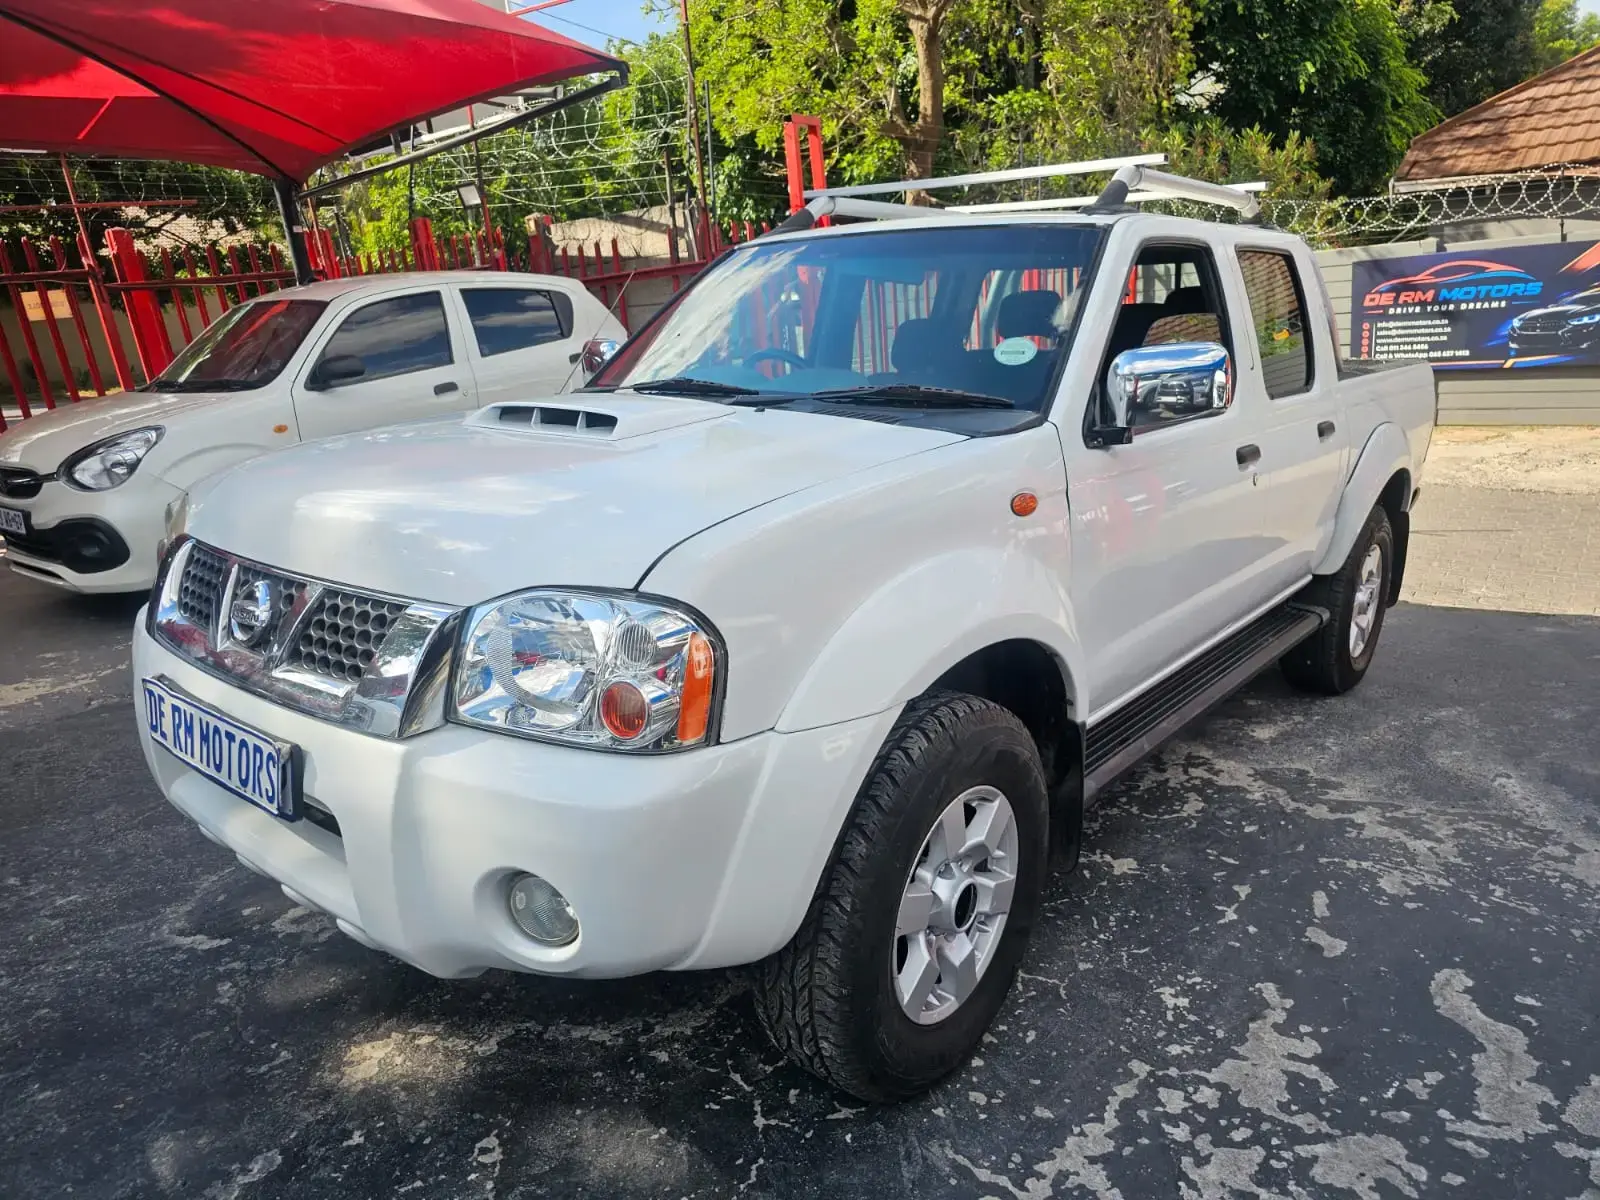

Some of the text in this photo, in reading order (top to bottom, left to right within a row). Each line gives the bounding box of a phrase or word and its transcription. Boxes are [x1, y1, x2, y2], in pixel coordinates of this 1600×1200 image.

[1363, 282, 1543, 306] DE RM MOTORS
[1388, 300, 1506, 314] DRIVE YOUR DREAMS
[149, 688, 276, 804] DE RM MOTORS
